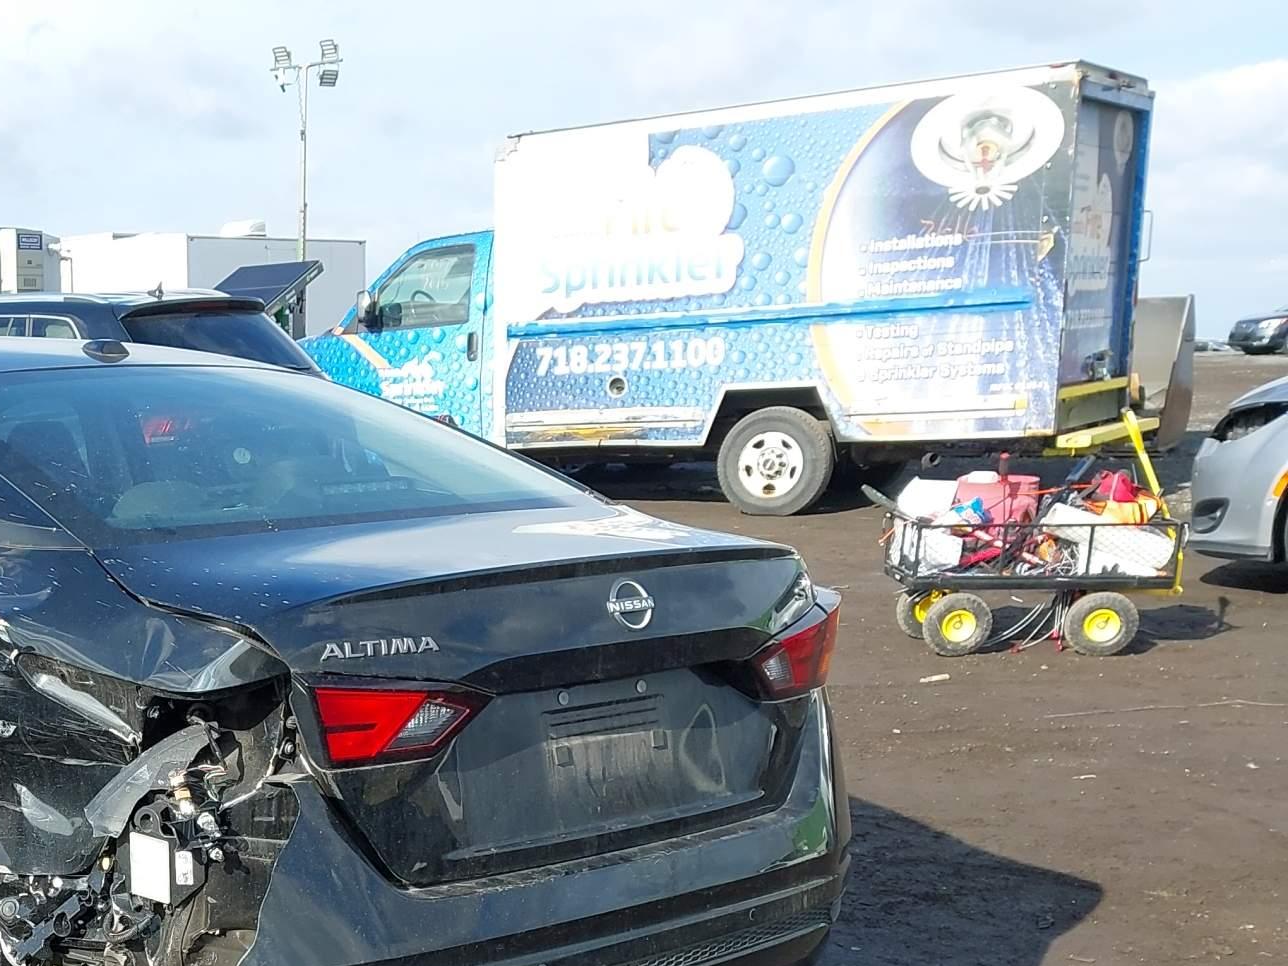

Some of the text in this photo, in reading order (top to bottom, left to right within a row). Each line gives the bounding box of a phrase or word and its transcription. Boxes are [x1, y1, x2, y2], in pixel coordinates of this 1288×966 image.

[870, 232, 962, 252] Installations
[540, 247, 724, 298] Sprinkler
[869, 255, 954, 276] Inspections
[867, 277, 962, 296] Maintenance
[865, 323, 919, 339] Testing
[536, 334, 725, 376] 718.237.1100
[936, 337, 1015, 358] Standpipe
[939, 363, 1006, 380] Systems
[608, 597, 655, 613] NISSAN
[320, 636, 440, 661] ALTIMA
